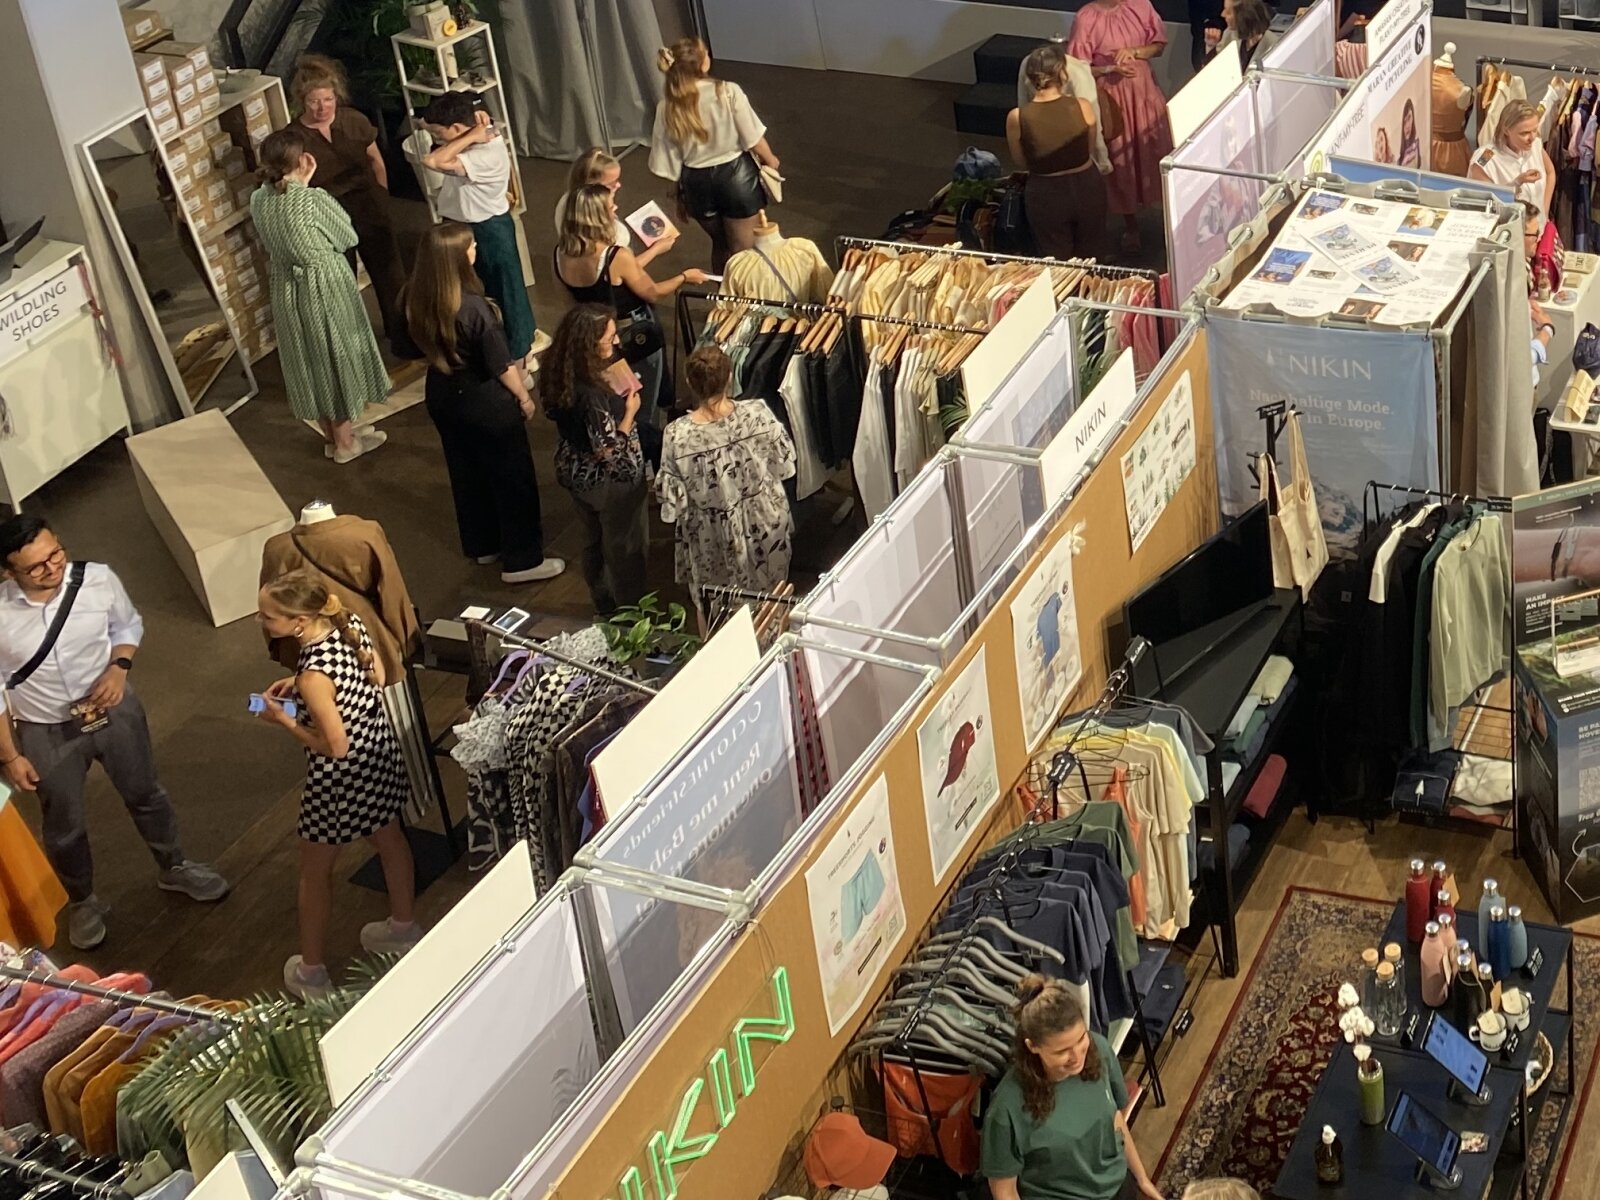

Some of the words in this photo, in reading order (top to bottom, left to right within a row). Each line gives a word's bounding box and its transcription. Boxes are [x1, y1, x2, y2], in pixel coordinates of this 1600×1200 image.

[0, 280, 67, 331] WILDLING
[12, 303, 60, 342] SHOES
[1289, 354, 1372, 381] NIKIN
[1347, 400, 1395, 415] Mode.
[1075, 401, 1107, 453] NIKIN
[1328, 413, 1387, 431] Europe.
[1526, 593, 1547, 604] MAKE
[1526, 601, 1537, 610] AN
[1578, 725, 1589, 733] BE
